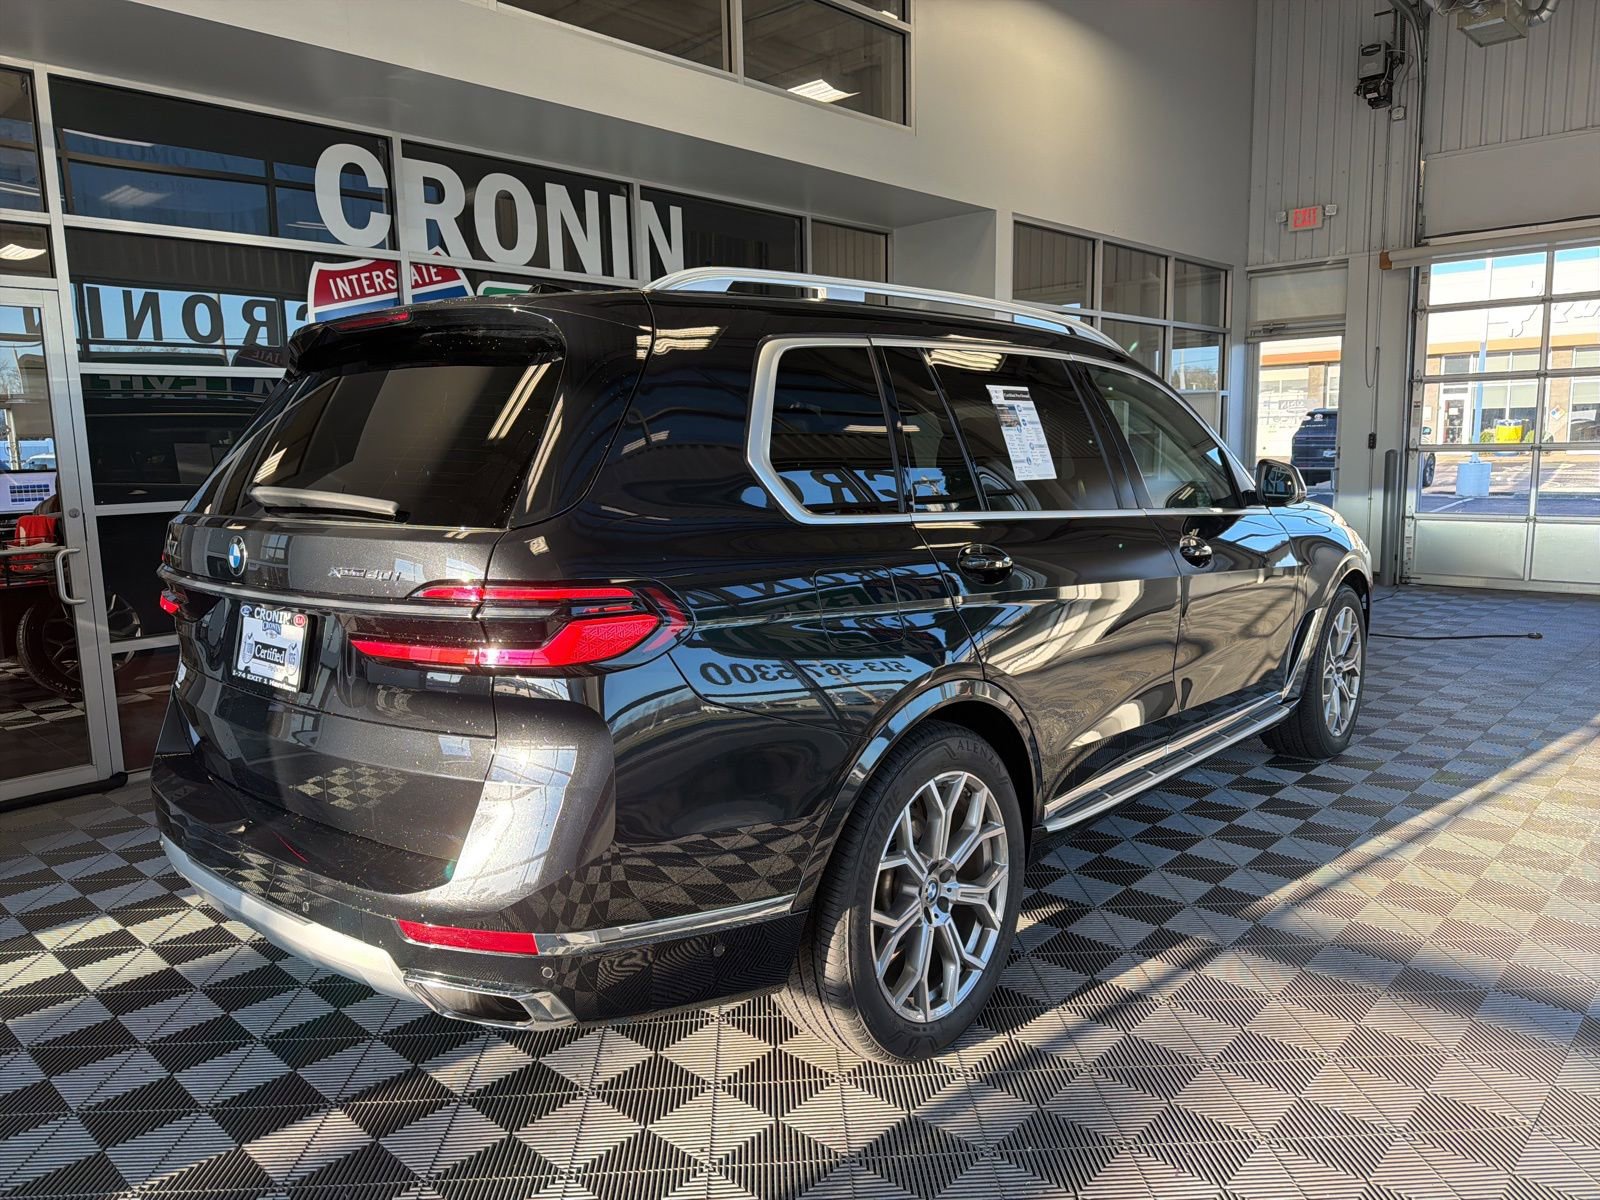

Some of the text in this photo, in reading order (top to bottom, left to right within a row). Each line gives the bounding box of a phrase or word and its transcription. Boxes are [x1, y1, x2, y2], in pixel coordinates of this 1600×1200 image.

[314, 143, 685, 279] CRONIN
[1293, 207, 1317, 228] EXIT
[329, 262, 442, 300] INTERSATE
[254, 607, 292, 626] CRONIN
[255, 645, 285, 664] Certified
[246, 673, 263, 683] EXIT
